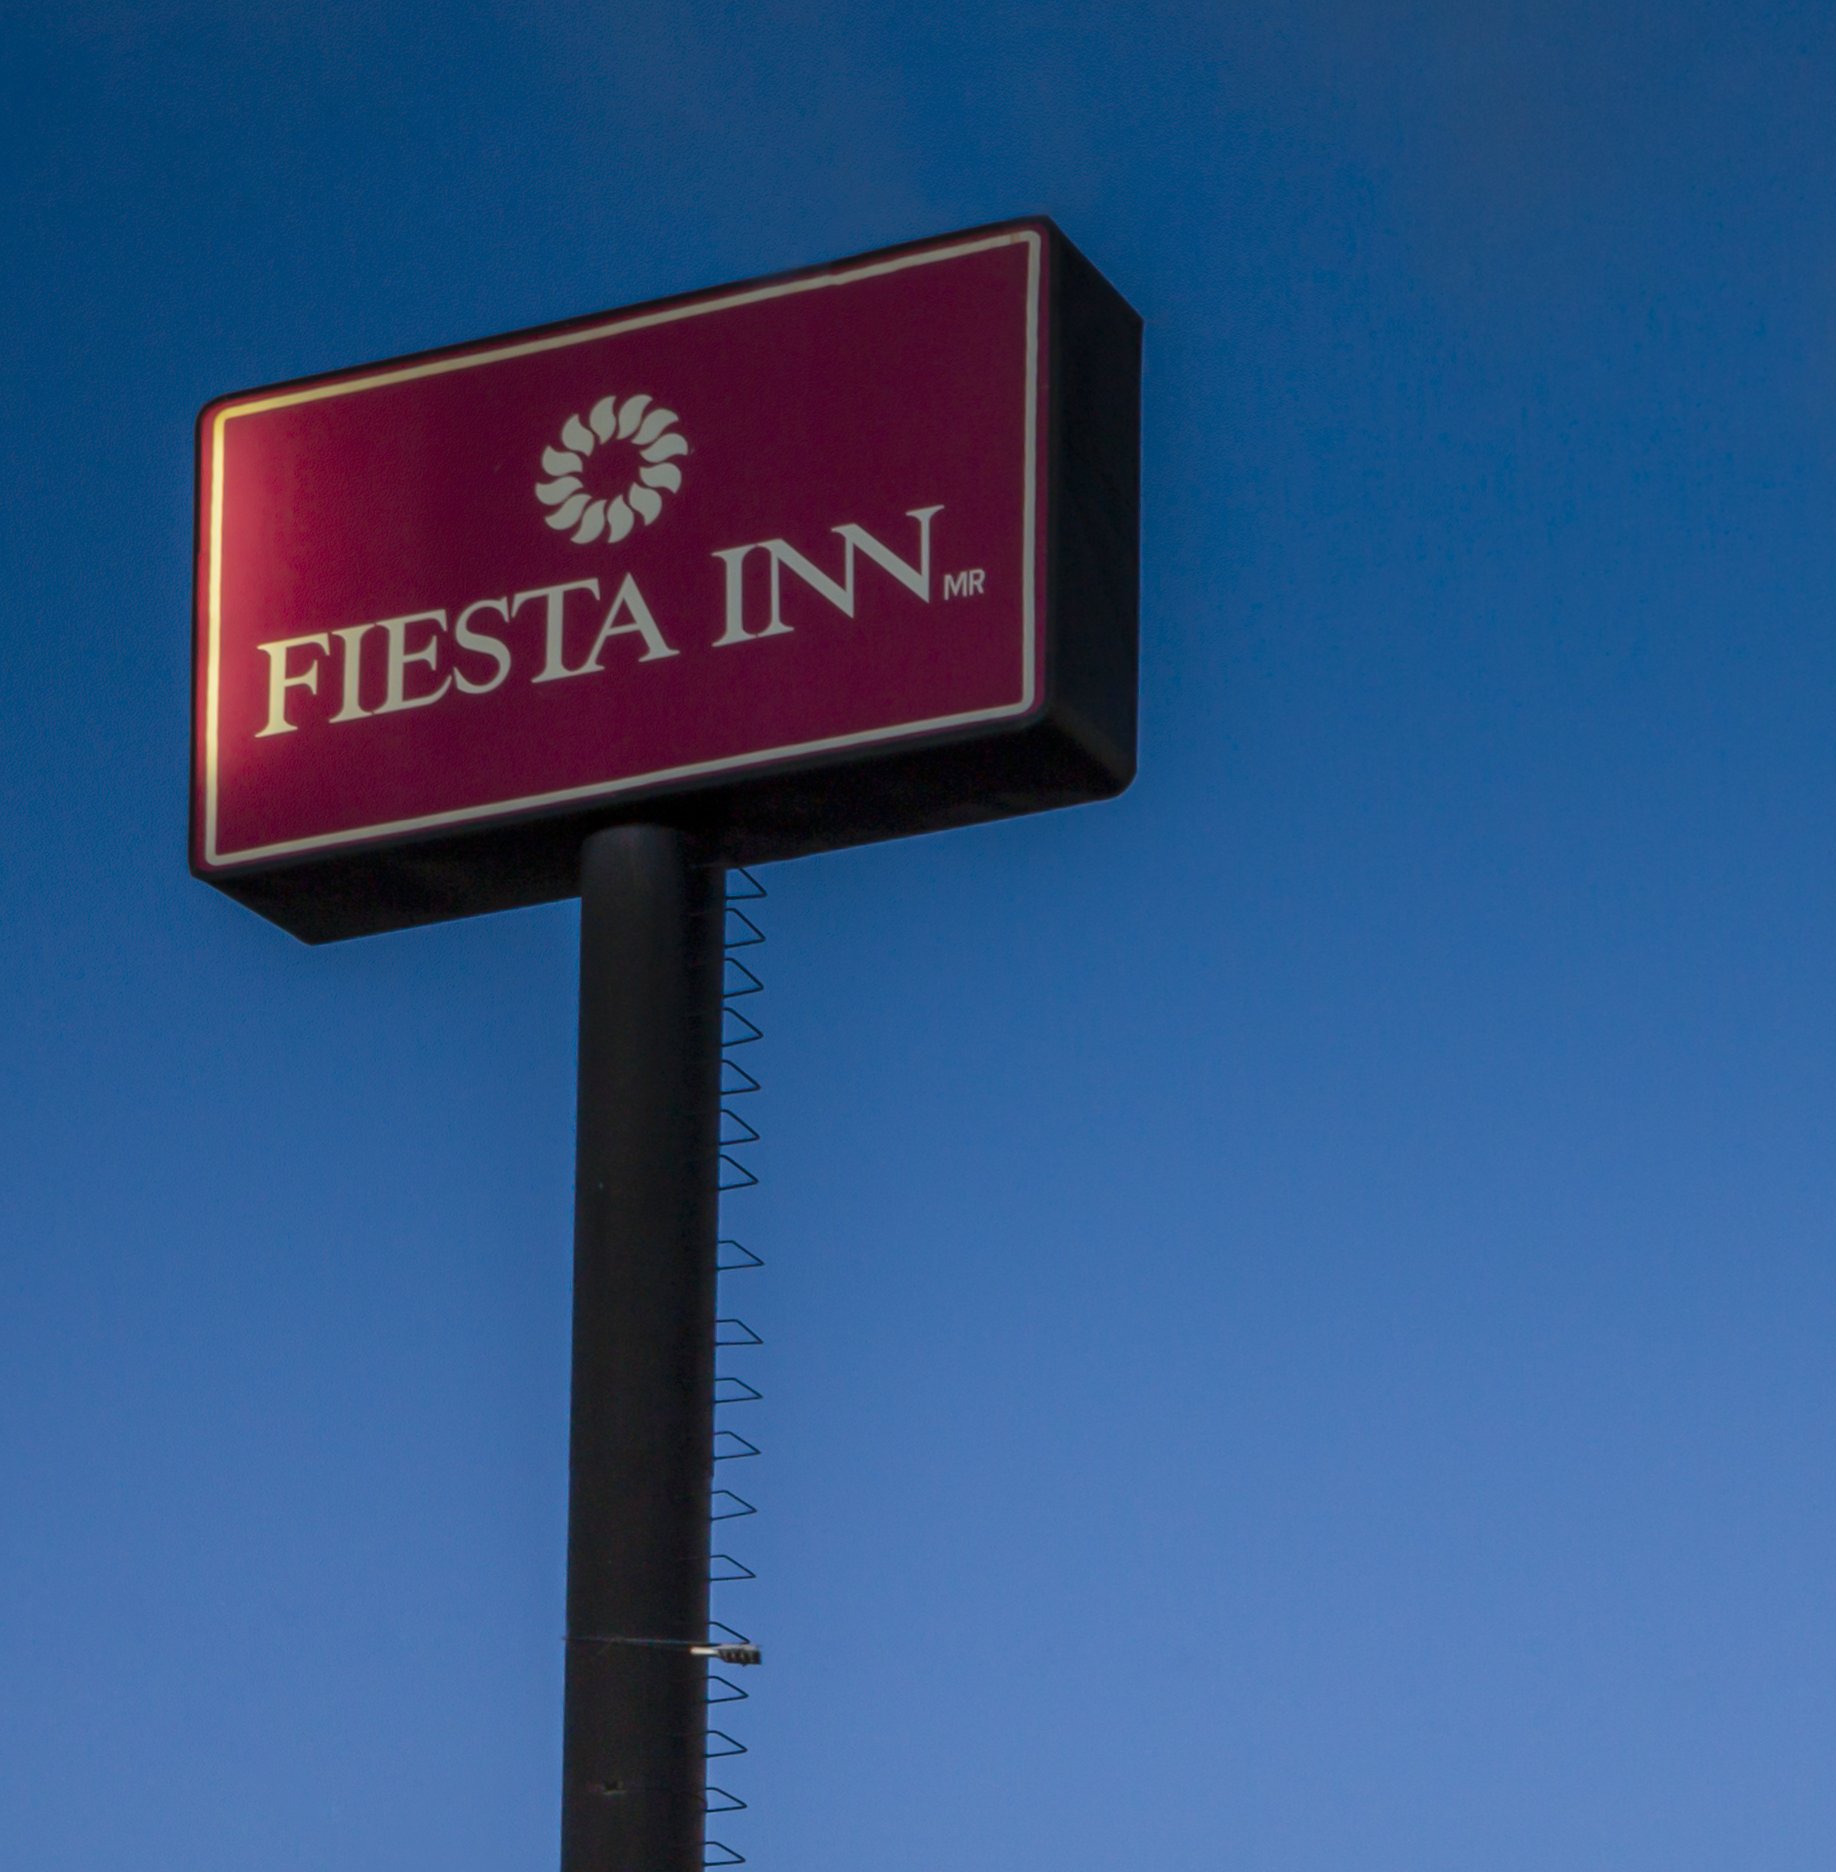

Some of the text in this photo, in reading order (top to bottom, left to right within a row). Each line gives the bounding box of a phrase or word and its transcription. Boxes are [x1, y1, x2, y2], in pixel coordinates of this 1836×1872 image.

[255, 504, 986, 738] FIESTA INN MR
